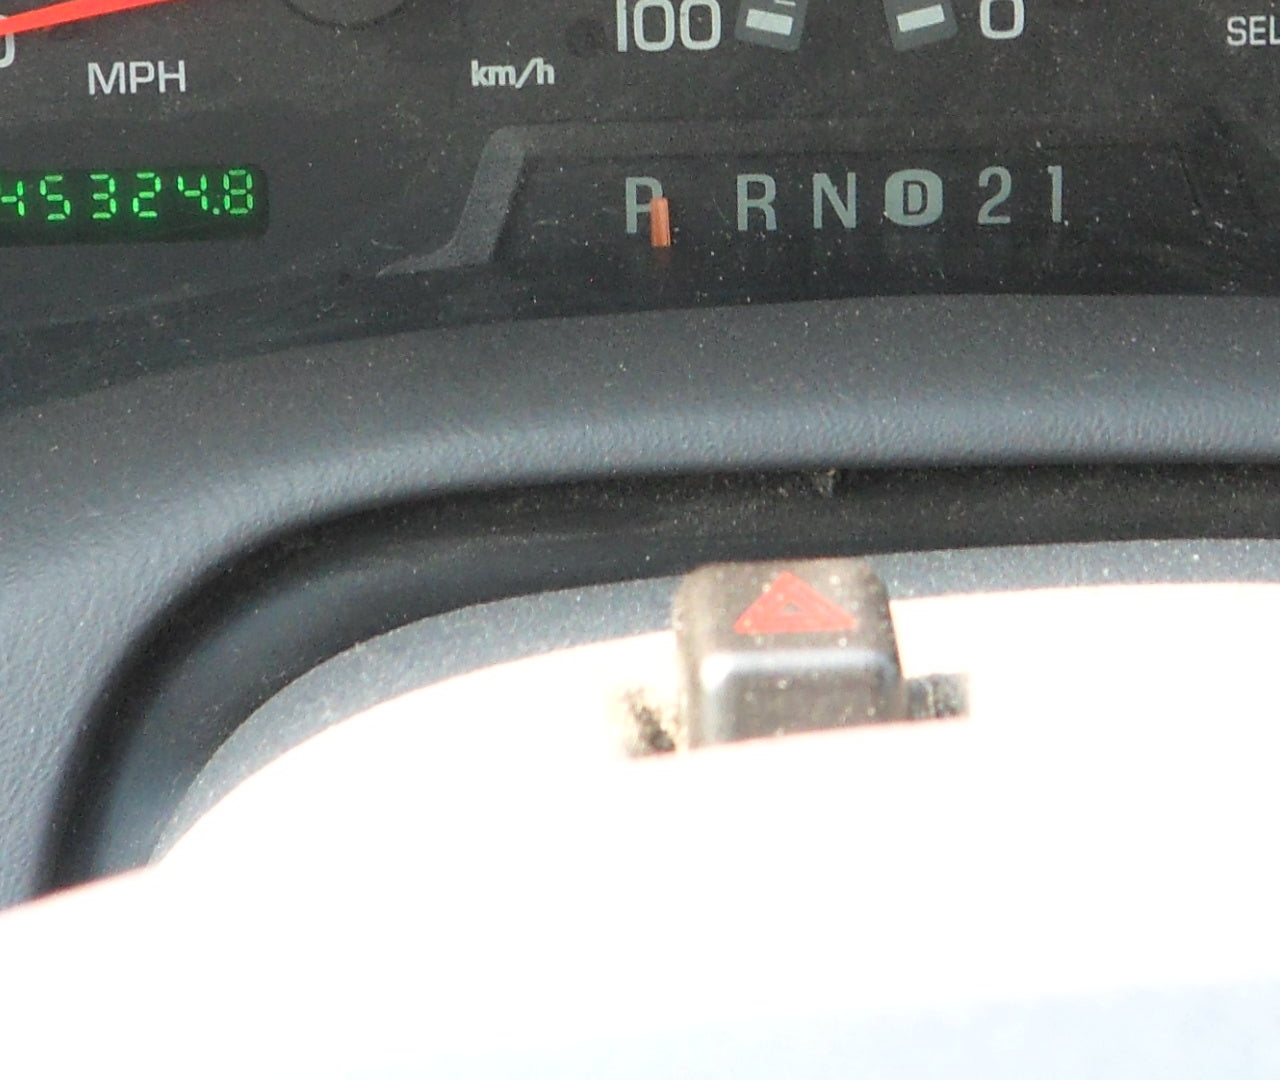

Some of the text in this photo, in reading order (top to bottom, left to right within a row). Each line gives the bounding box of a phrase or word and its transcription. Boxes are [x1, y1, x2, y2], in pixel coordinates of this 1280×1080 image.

[87, 59, 186, 95] MPH
[471, 57, 555, 89] km/h
[736, 173, 777, 231] R
[812, 171, 857, 229] N
[977, 166, 1012, 225] 2
[1047, 165, 1063, 223] 1
